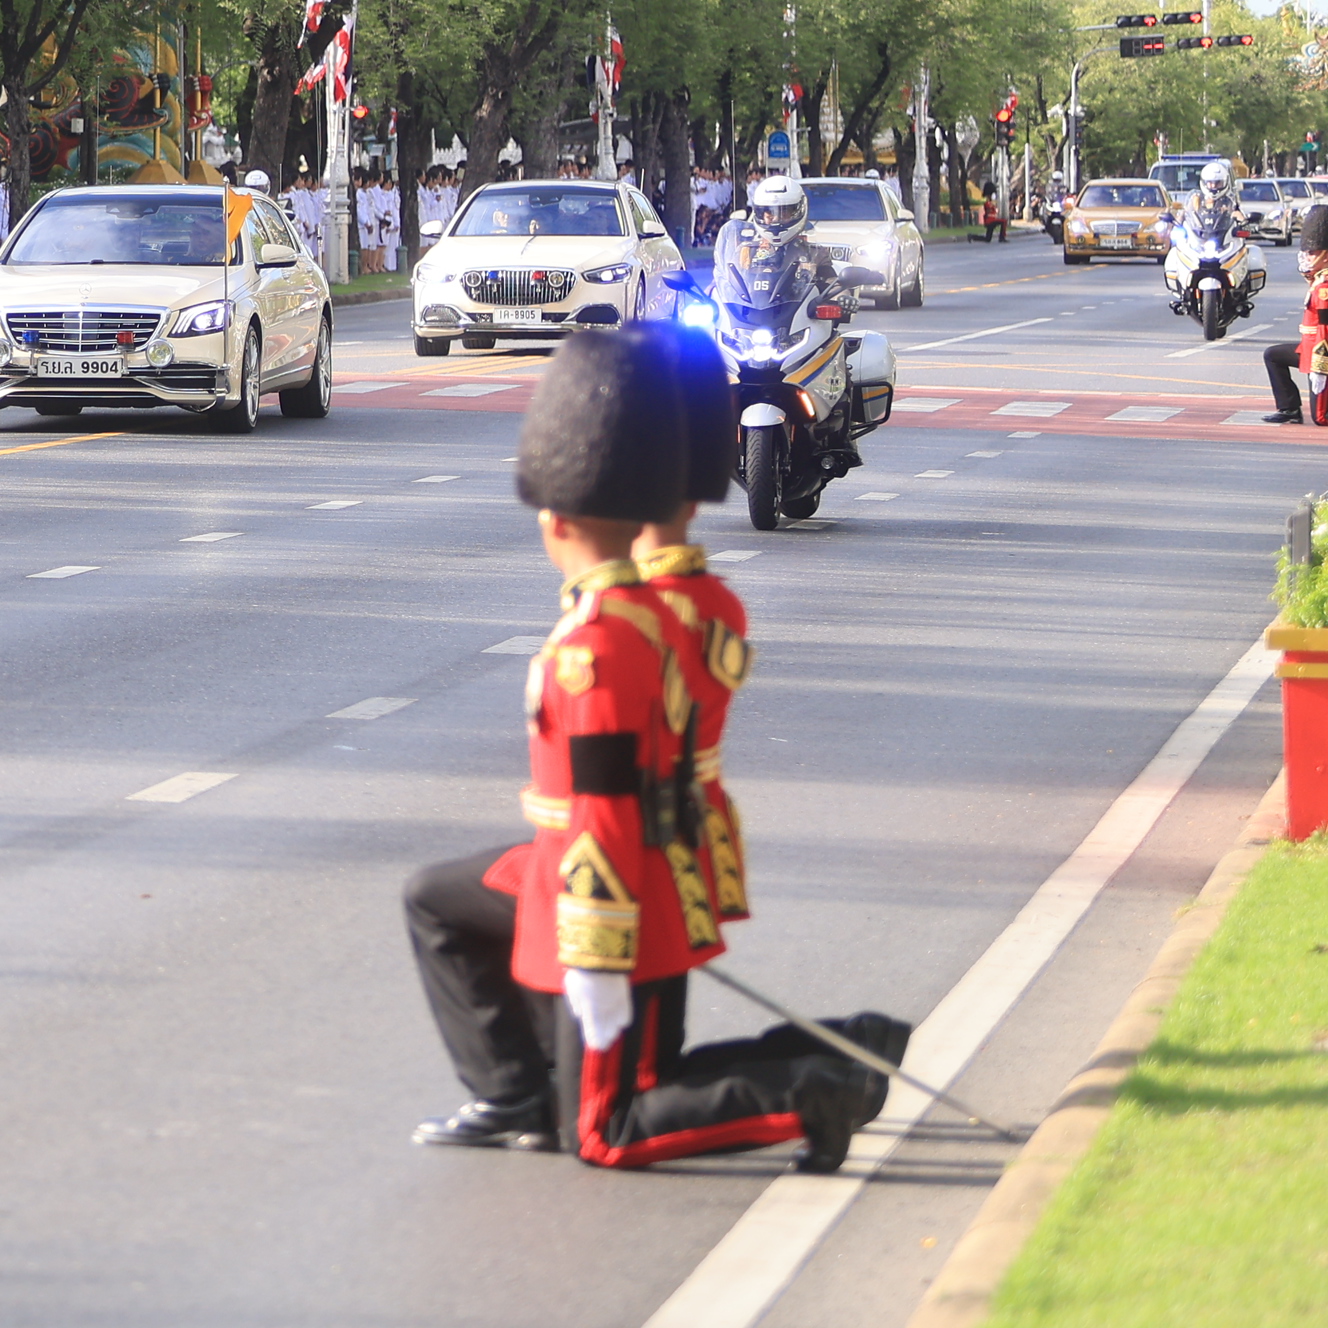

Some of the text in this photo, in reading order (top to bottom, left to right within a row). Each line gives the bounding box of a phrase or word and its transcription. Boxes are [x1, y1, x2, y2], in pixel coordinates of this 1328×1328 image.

[754, 280, 769, 290] 05
[41, 361, 118, 374] ร.ย.ล. 9904
